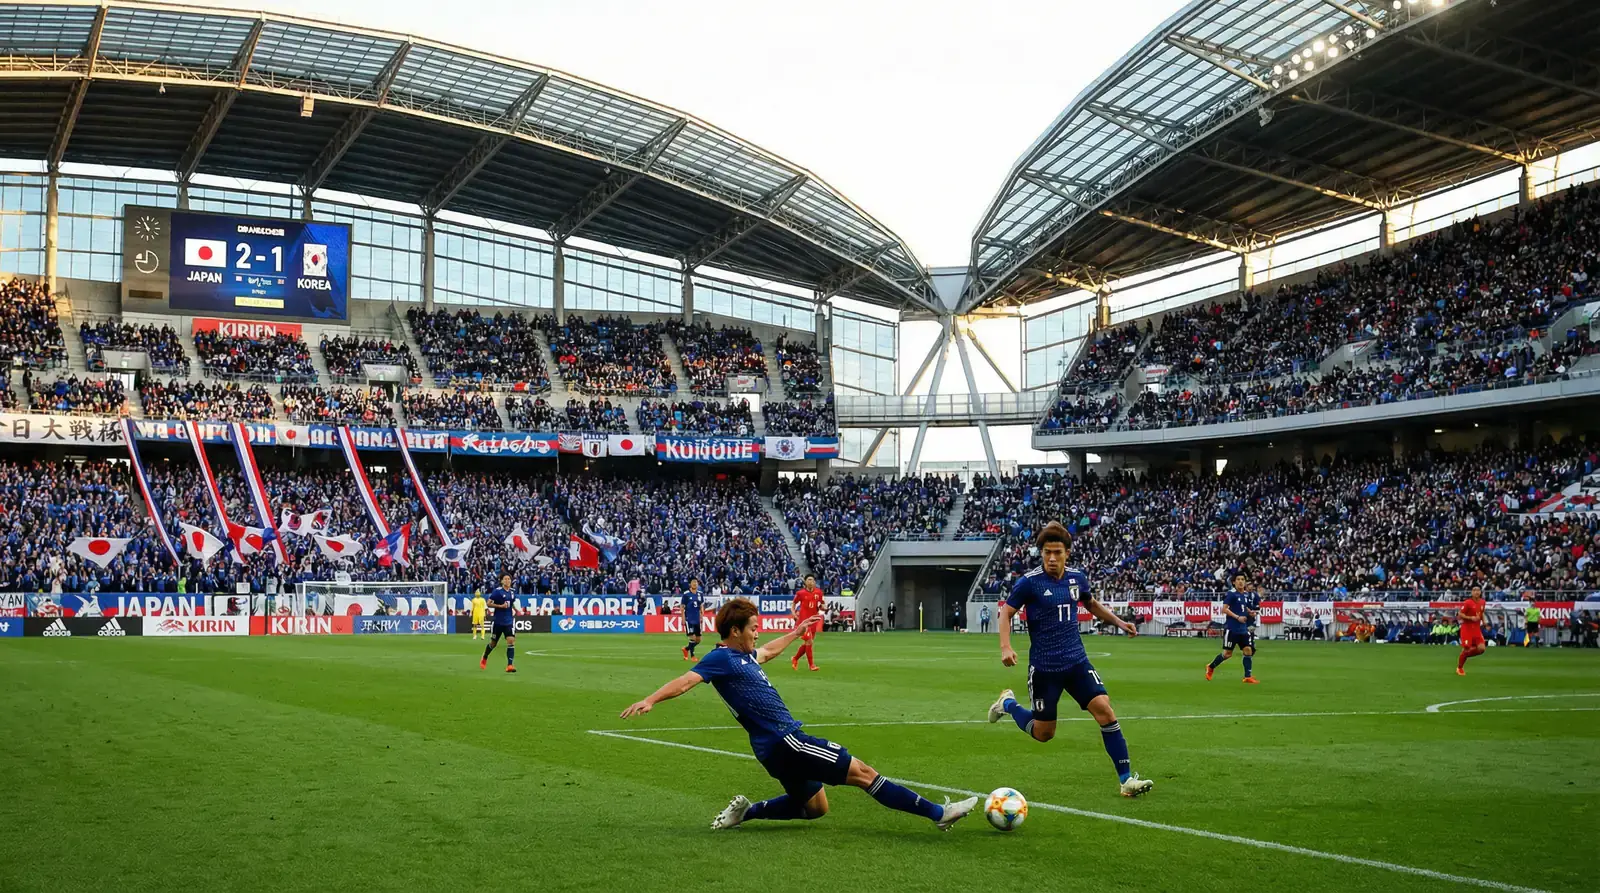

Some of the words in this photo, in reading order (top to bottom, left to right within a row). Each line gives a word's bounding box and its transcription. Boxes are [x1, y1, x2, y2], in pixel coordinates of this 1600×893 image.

[187, 270, 223, 284] JAPAN
[297, 278, 332, 290] KOREA
[114, 596, 196, 616] JAPAN
[1057, 603, 1071, 621] 17
[1185, 606, 1210, 616] KIRIN
[1539, 608, 1571, 619] KIRIN
[188, 620, 236, 633] KIRIN
[271, 617, 332, 634] KIRIN
[98, 629, 126, 637] adidas
